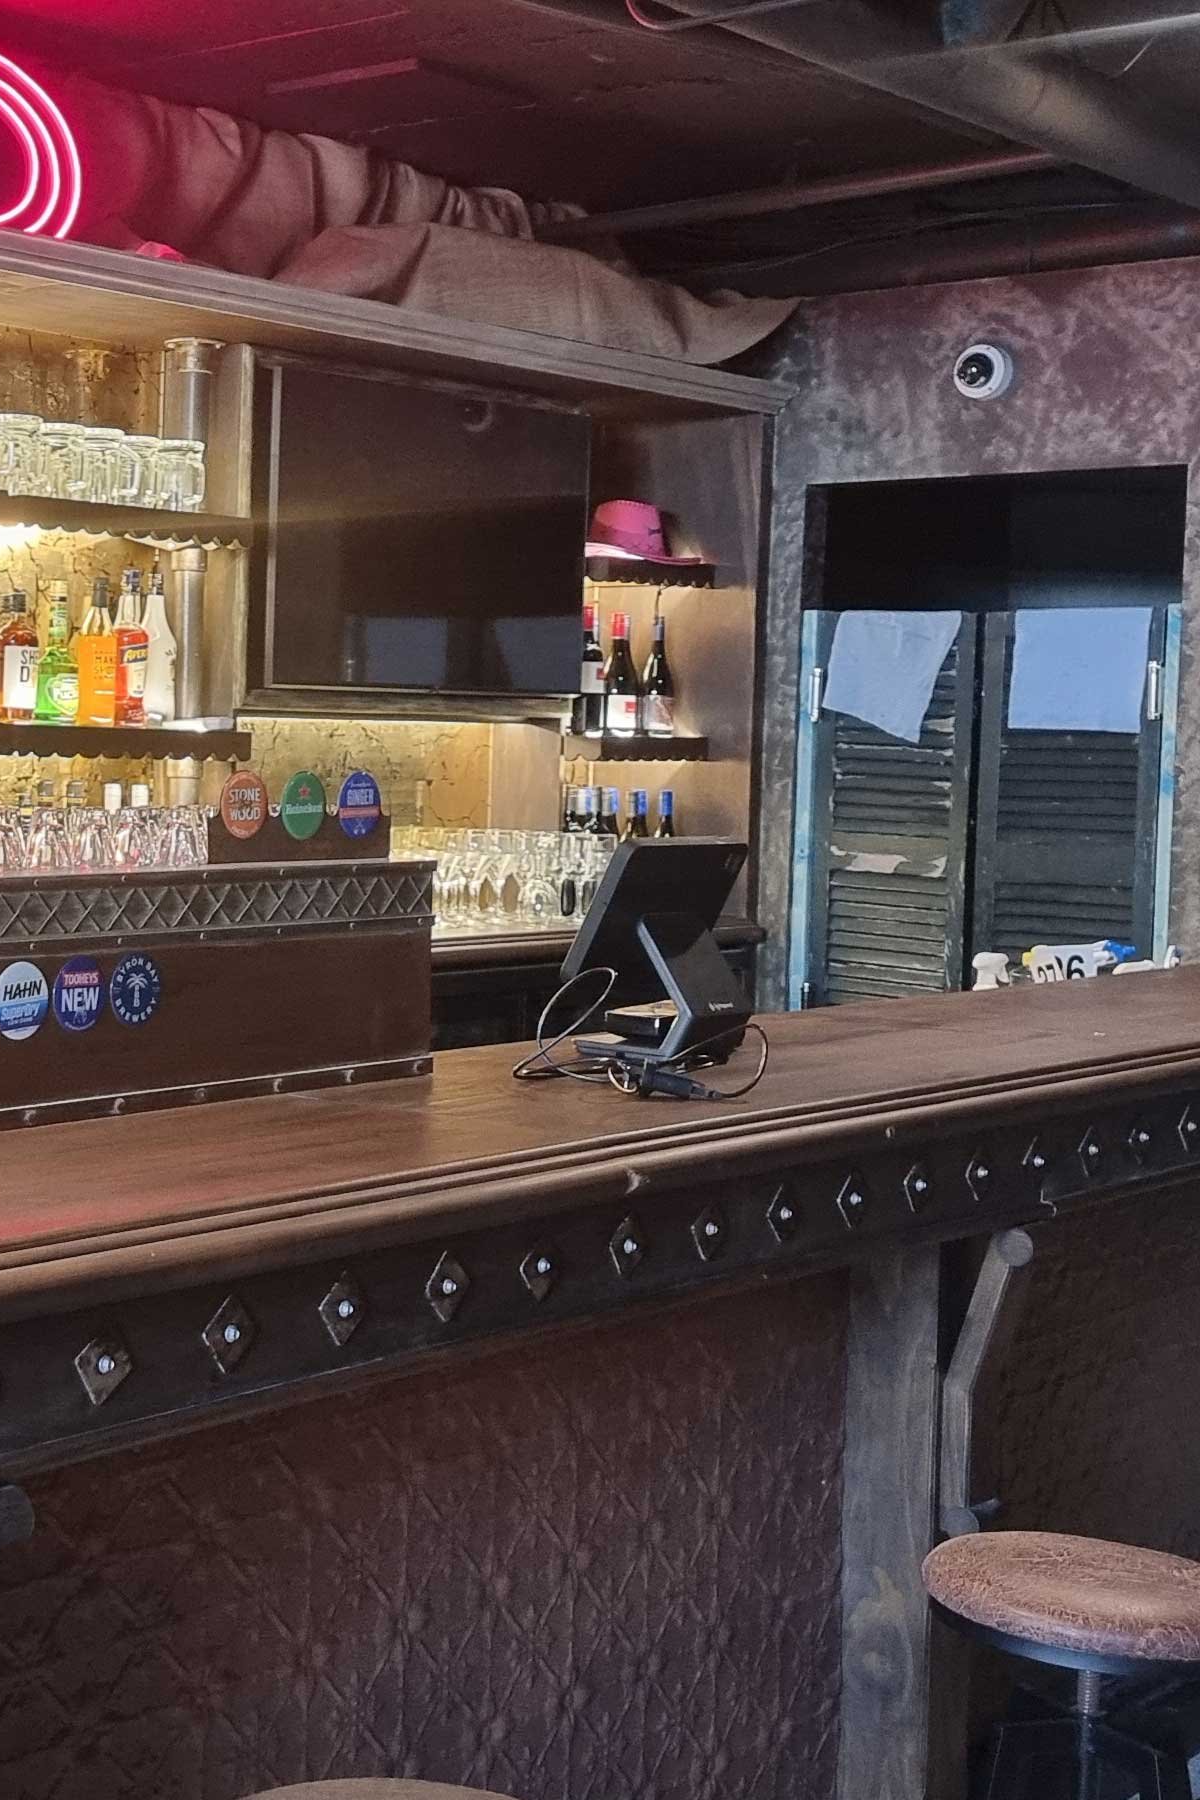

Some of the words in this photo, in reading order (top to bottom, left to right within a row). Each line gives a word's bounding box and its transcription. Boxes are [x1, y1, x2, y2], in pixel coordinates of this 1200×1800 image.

[229, 788, 261, 802] STONE
[230, 807, 261, 821] WOOD
[64, 972, 99, 985] TOOHEYS
[116, 957, 144, 983] BYRON
[145, 962, 160, 983] BAY
[3, 979, 43, 1001] HAHN
[61, 986, 99, 1013] NEW
[115, 997, 157, 1023] BREWERY
